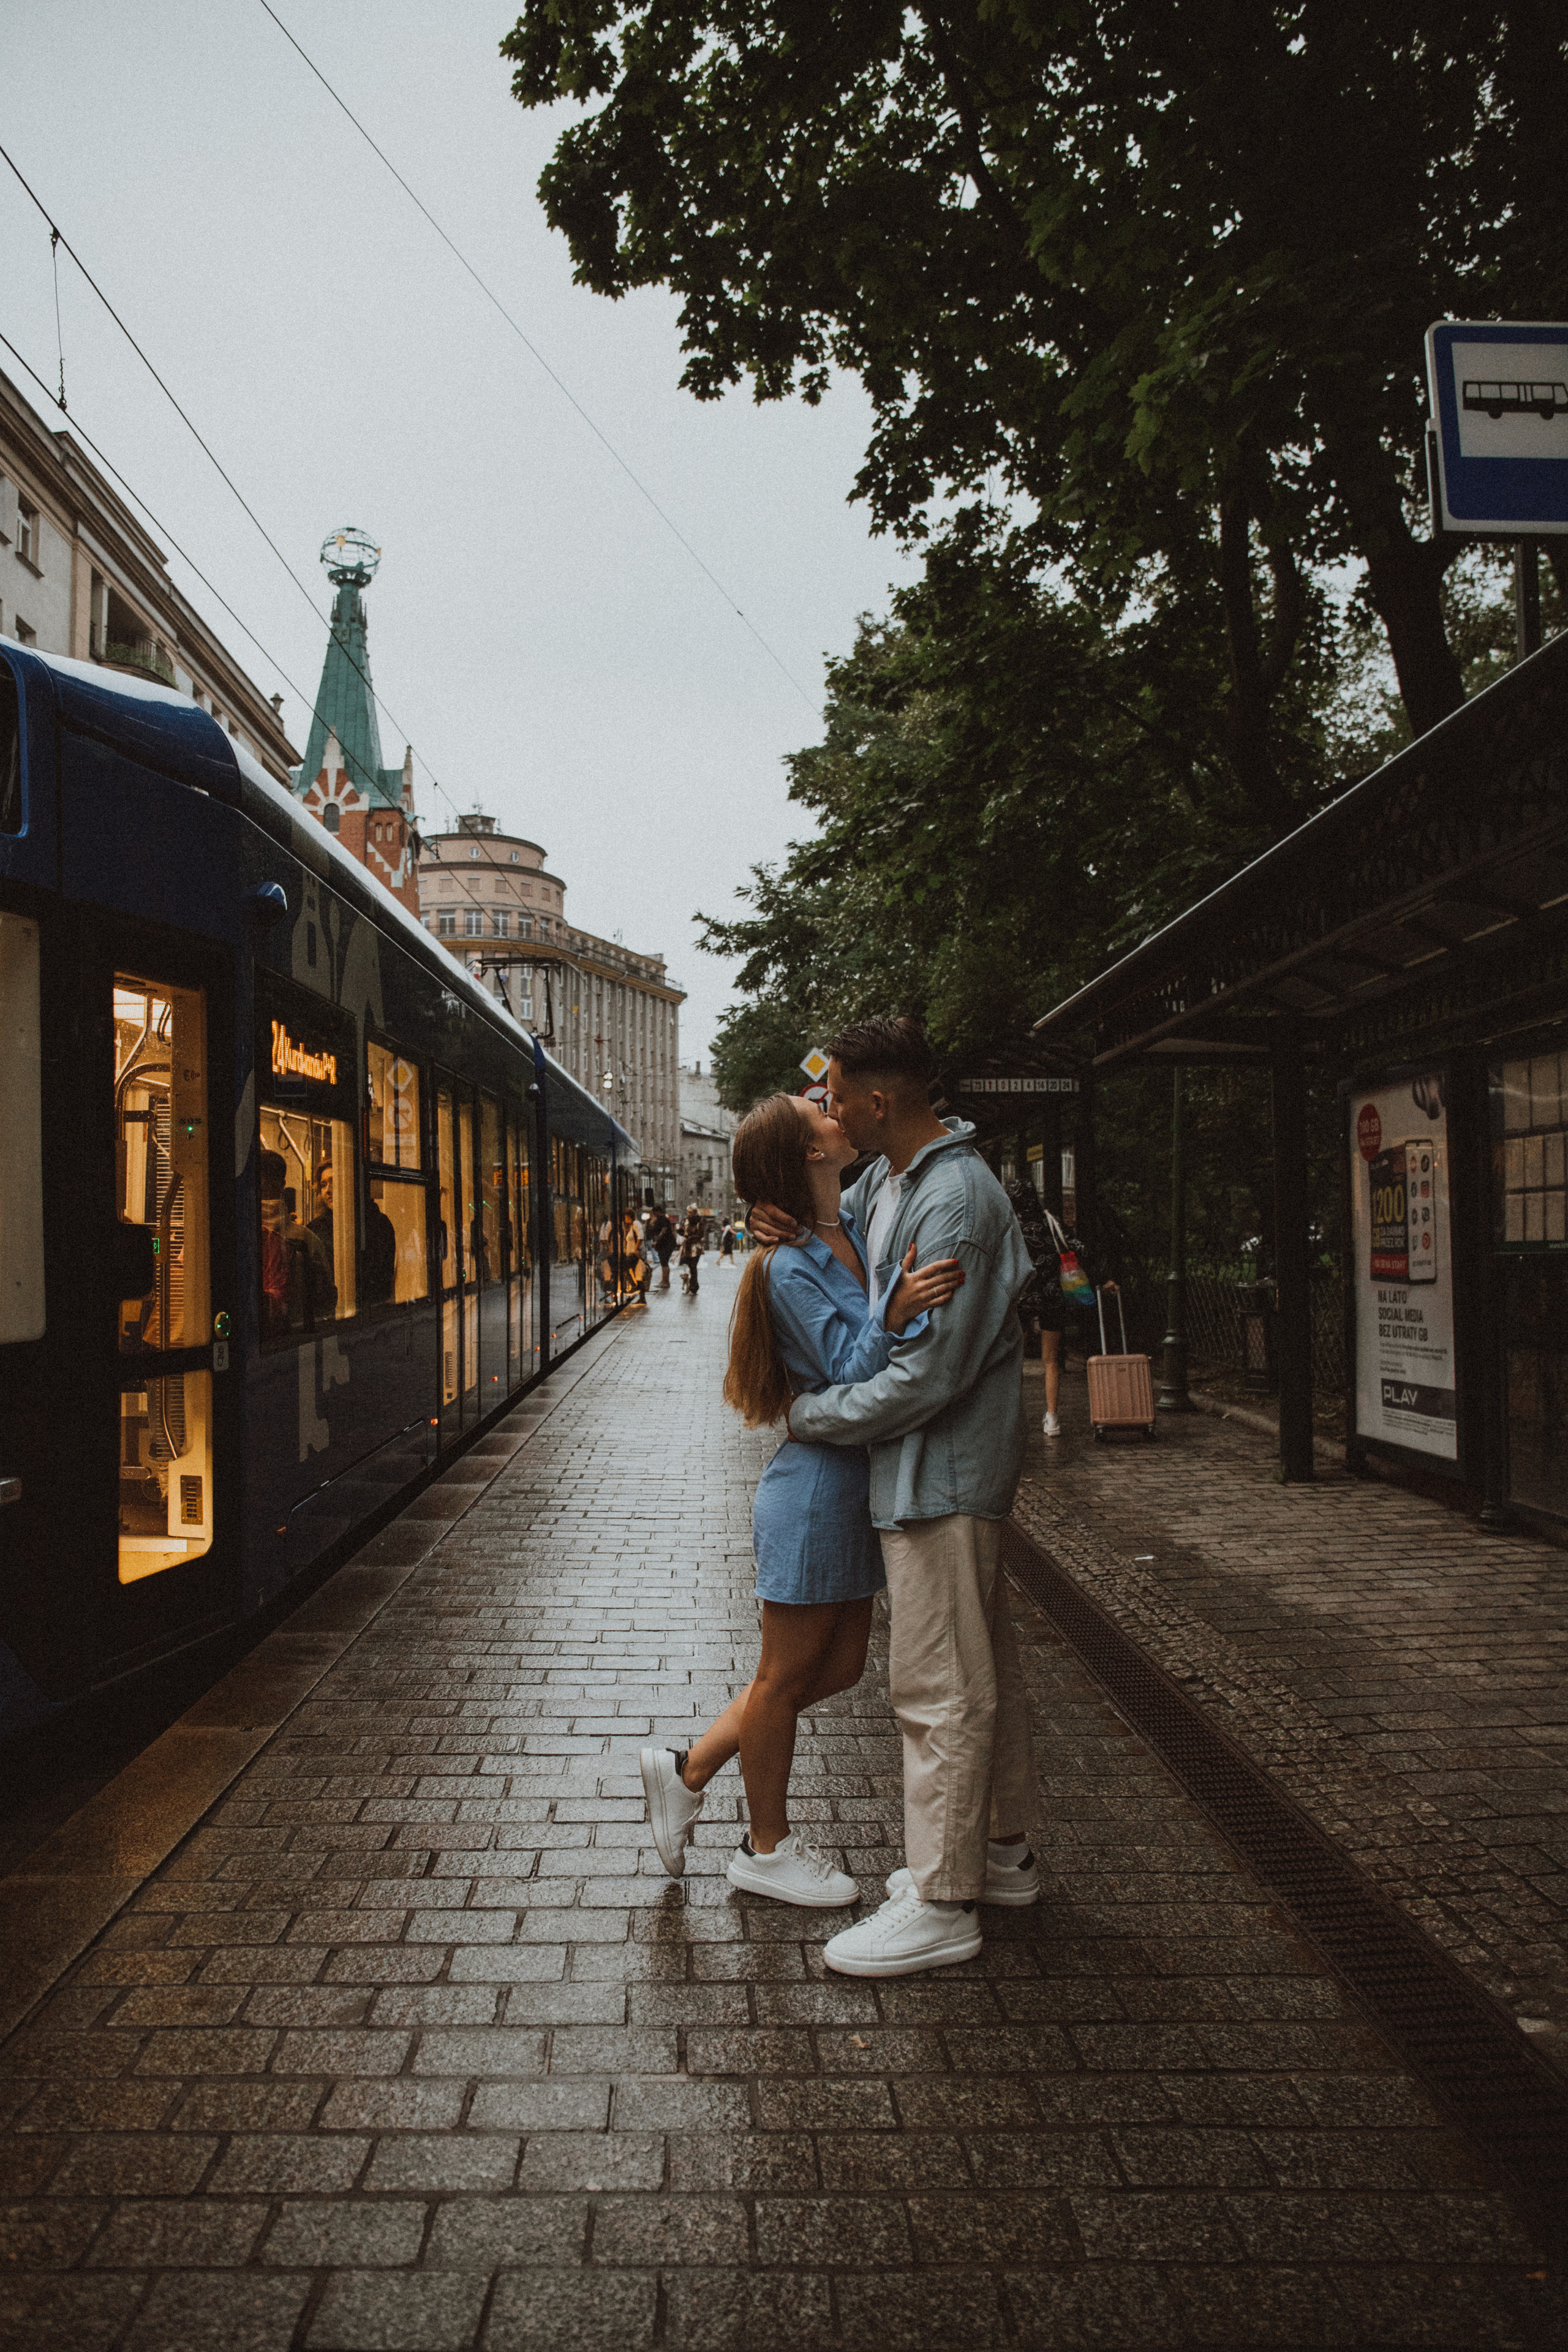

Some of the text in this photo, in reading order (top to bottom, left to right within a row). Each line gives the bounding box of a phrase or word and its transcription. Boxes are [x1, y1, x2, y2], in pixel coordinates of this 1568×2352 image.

[272, 1020, 286, 1074] 24
[323, 1052, 337, 1085] P+R
[1373, 1184, 1404, 1224] 1200
[1378, 1290, 1407, 1303] NA LATO
[1378, 1307, 1423, 1323] SOCIAL MEDIA
[1379, 1324, 1428, 1341] BEZ UTRATY GB
[1384, 1385, 1418, 1406] PLAY
